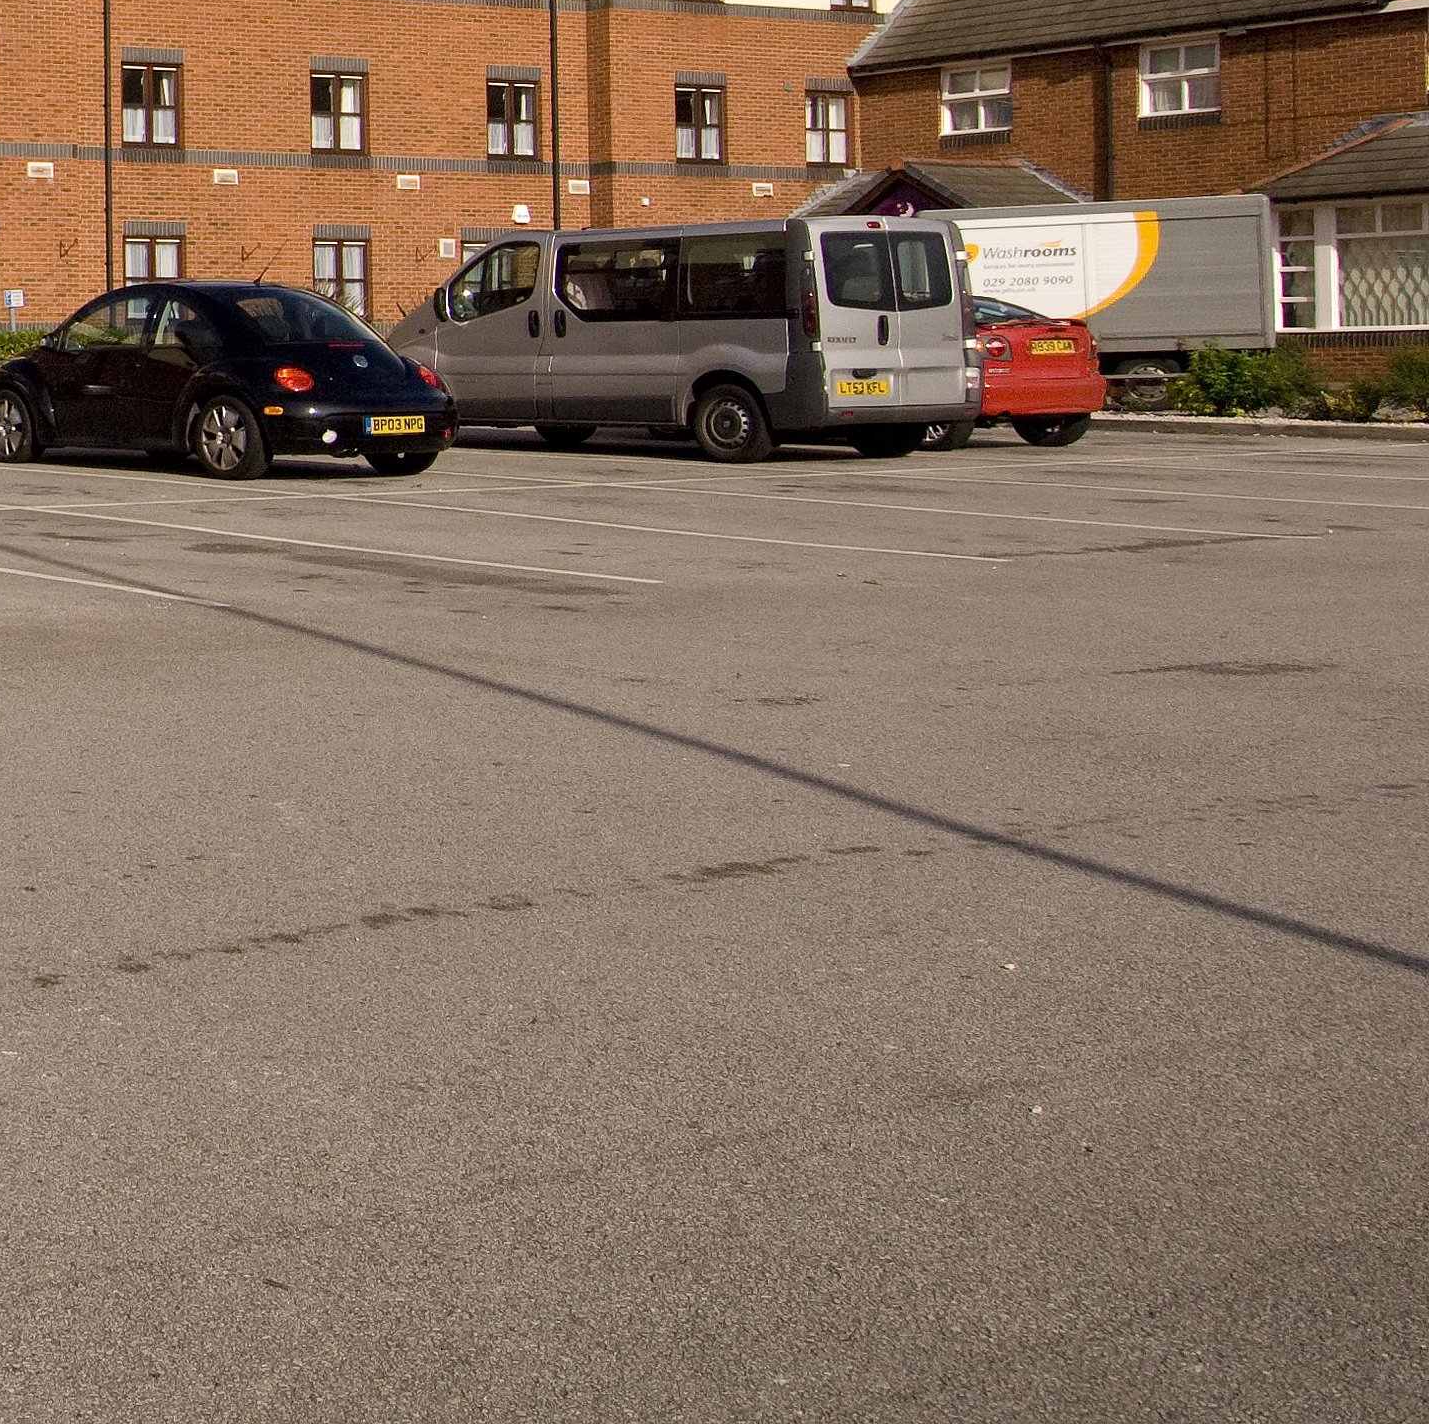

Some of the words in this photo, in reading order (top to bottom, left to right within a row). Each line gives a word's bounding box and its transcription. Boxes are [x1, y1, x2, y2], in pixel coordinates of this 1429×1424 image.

[982, 246, 1078, 260] Washrooms
[983, 277, 1006, 287] 029
[1009, 276, 1039, 286] 2080
[1042, 275, 1074, 285] 9090
[839, 381, 864, 395] LT53
[866, 381, 885, 395] KFL
[373, 418, 402, 432] BP03
[404, 417, 423, 431] NPG
